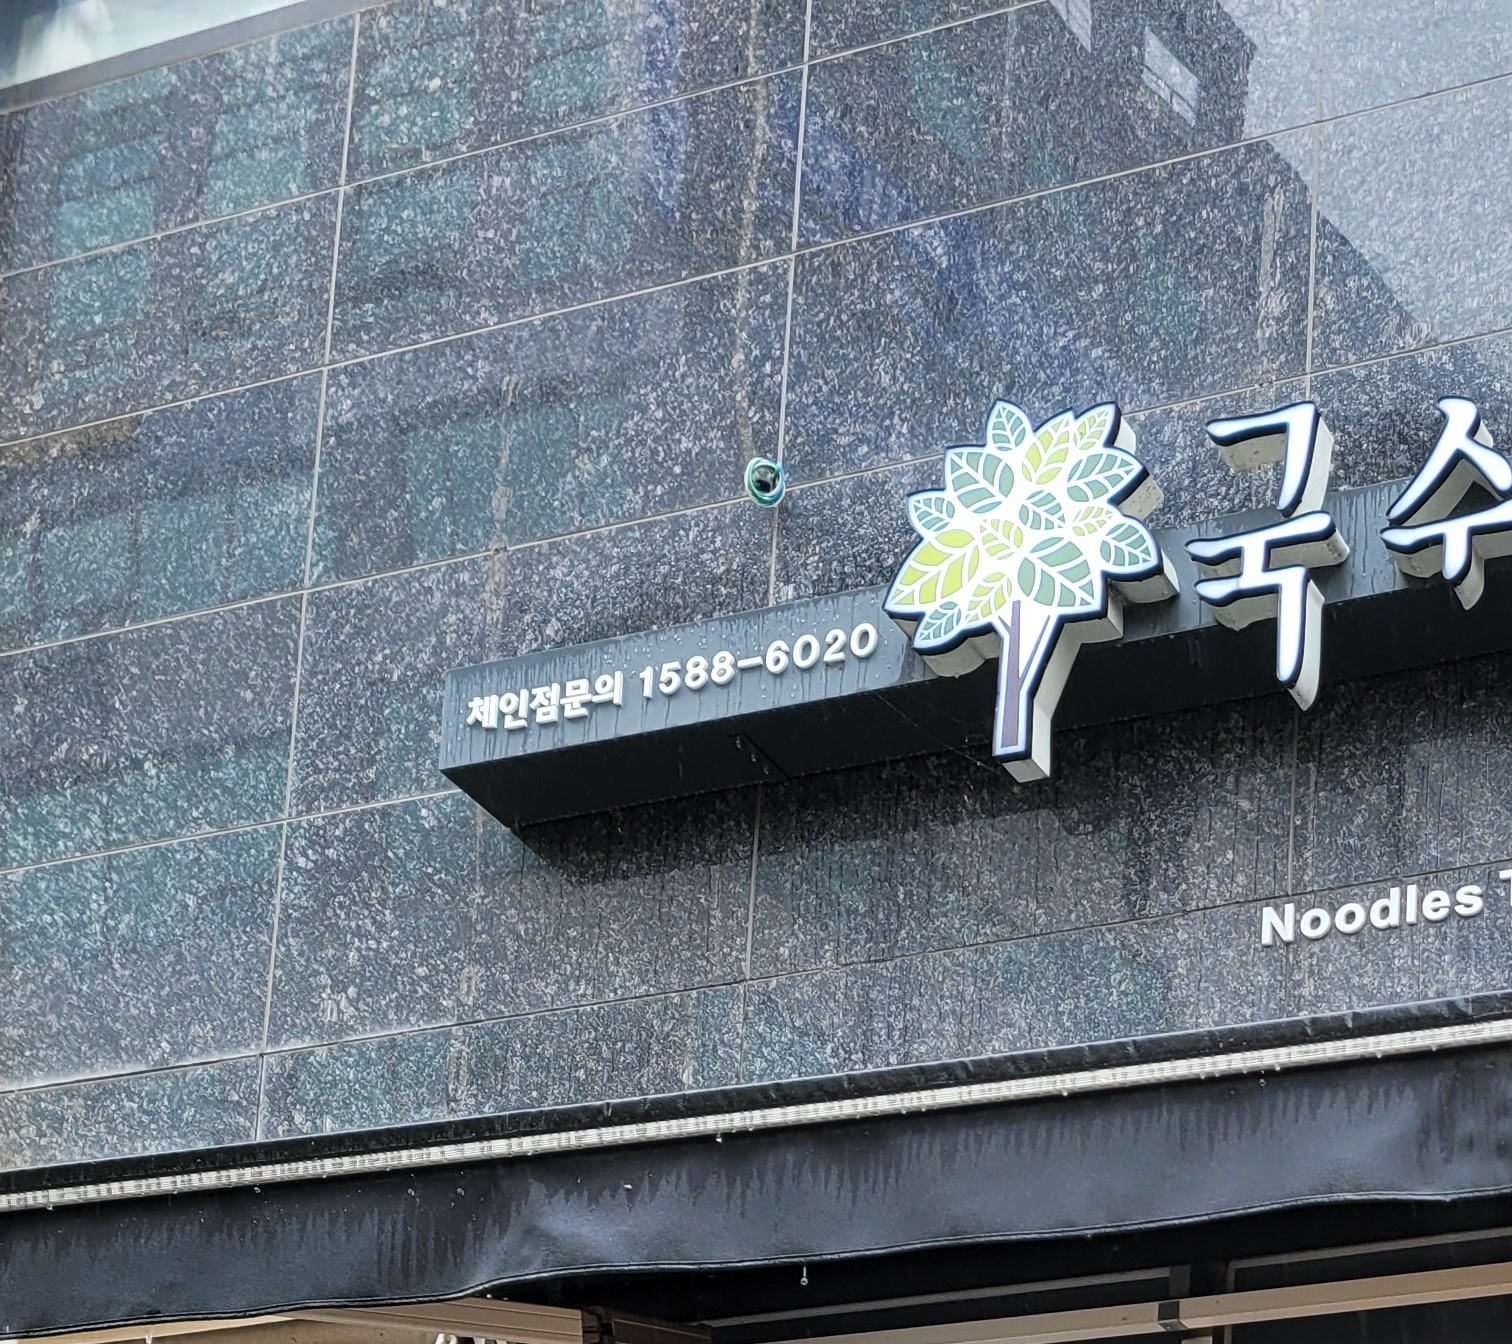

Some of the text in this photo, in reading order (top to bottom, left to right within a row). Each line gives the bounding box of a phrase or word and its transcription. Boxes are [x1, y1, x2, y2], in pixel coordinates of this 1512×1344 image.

[465, 621, 879, 732] 체인점문의 1588-6020
[1259, 880, 1486, 946] Noodles
